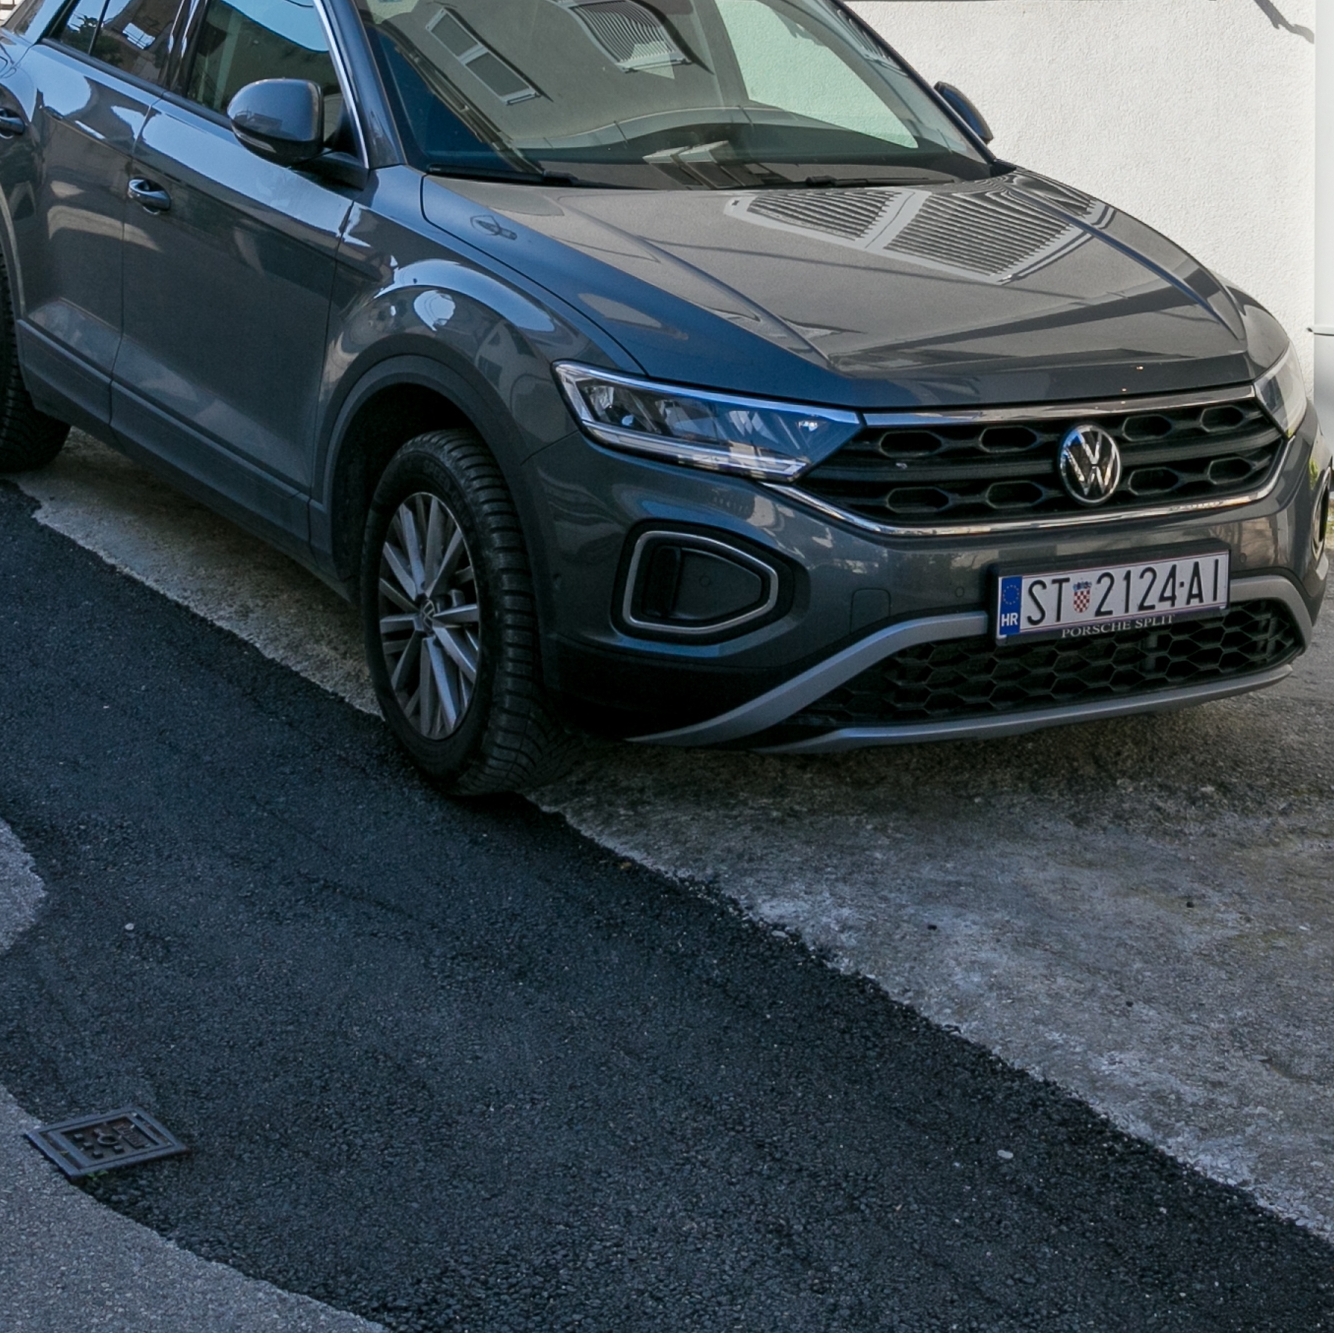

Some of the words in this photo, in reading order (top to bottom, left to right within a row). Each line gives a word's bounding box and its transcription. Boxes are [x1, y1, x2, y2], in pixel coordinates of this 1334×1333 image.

[1027, 577, 1071, 625] ST
[1001, 612, 1019, 627] HR
[1061, 620, 1132, 638] PORSCHE
[1135, 614, 1175, 629] SPLIT
